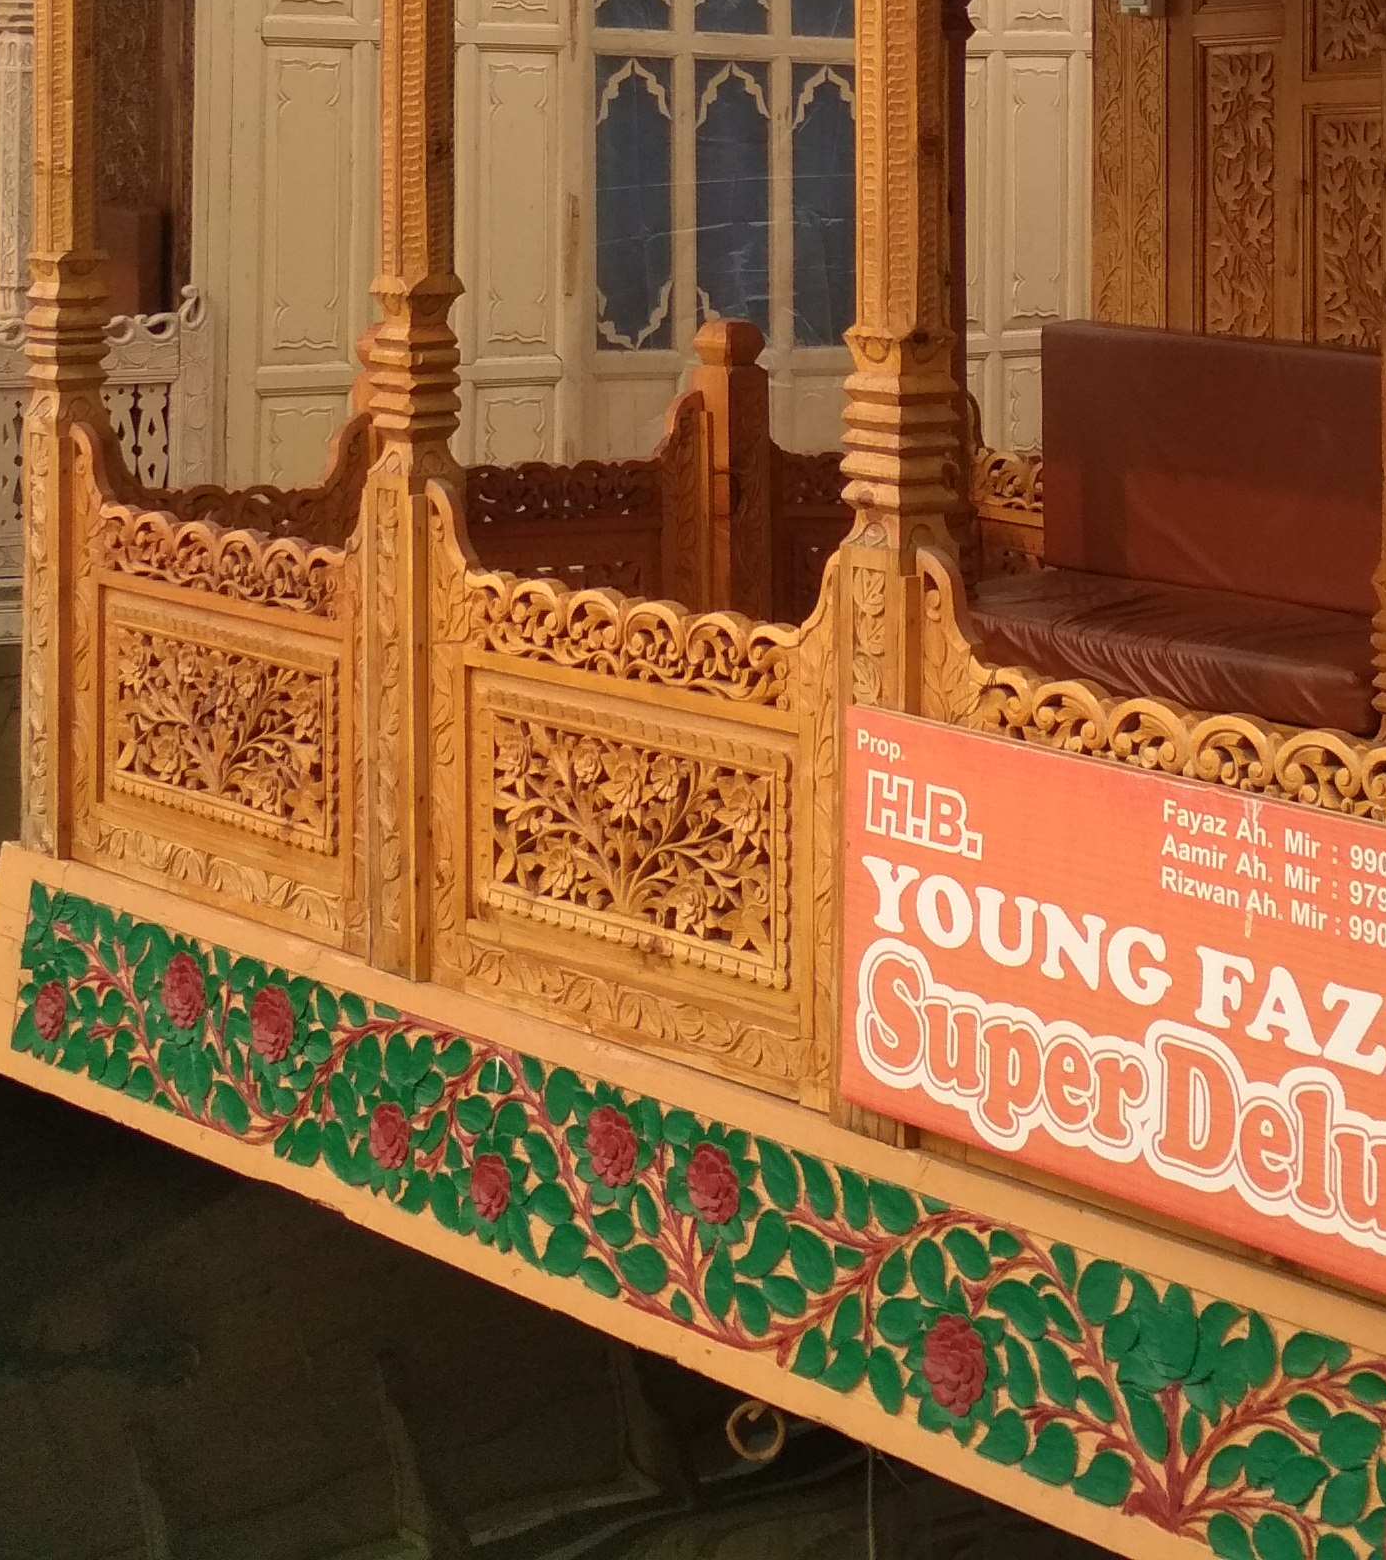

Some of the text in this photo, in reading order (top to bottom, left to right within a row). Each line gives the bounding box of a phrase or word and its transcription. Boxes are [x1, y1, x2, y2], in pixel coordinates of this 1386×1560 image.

[857, 729, 906, 763] Prop.
[865, 769, 983, 861] H.B.
[1163, 799, 1227, 837] Fayaz
[1235, 817, 1273, 848] Ah.
[1284, 828, 1321, 859] Mir
[1161, 833, 1228, 870] Aamir
[1235, 852, 1273, 883] Ah.
[1284, 863, 1321, 894] Mir
[861, 855, 1173, 1005] YOUNG
[1161, 865, 1239, 909] Rizwan
[1245, 889, 1283, 920] Ah.
[1291, 899, 1328, 931] Mir
[856, 937, 1150, 1161] Super
